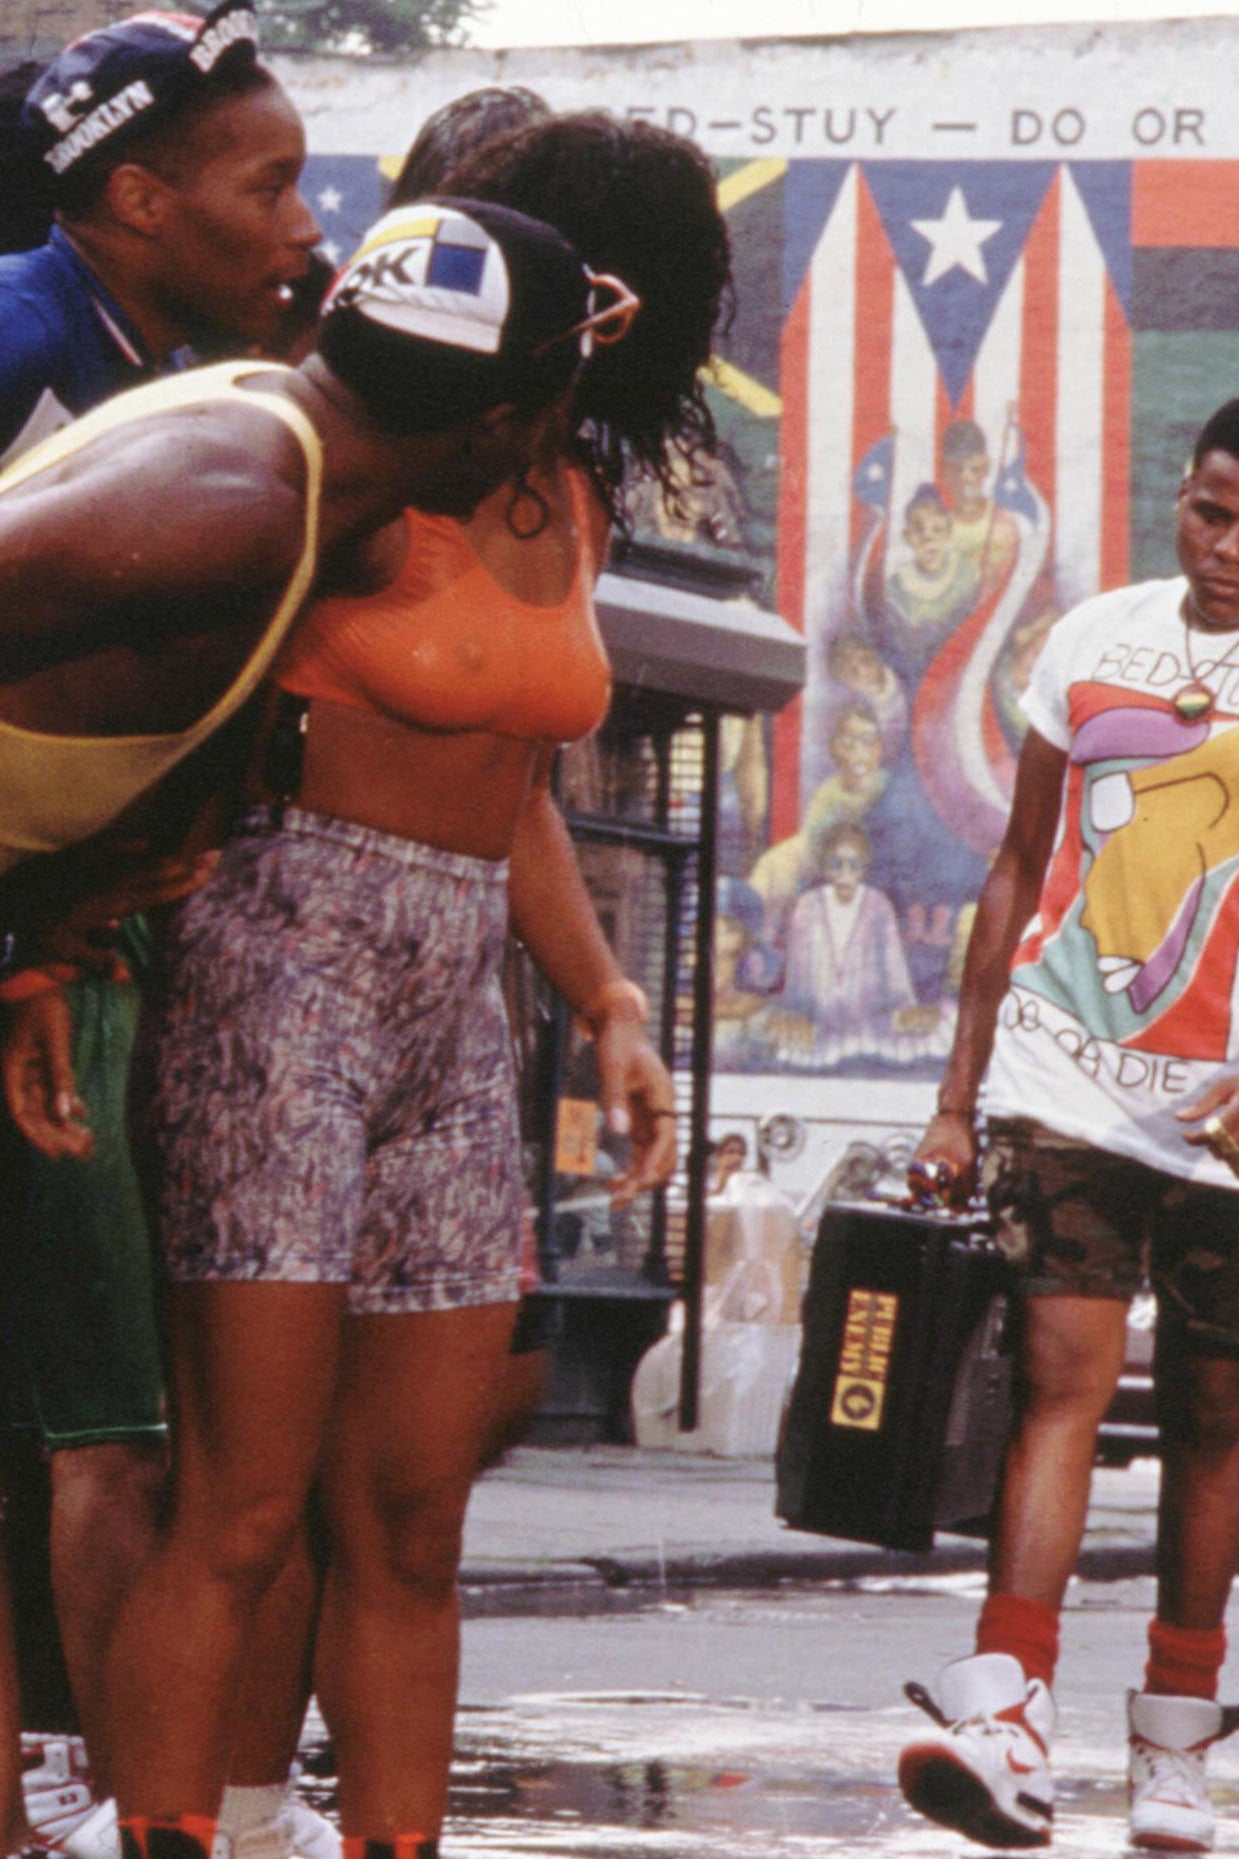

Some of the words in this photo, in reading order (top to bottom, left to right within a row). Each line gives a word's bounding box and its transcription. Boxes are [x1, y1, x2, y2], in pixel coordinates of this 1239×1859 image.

[1010, 108, 1087, 146] DO
[1131, 107, 1205, 146] OR
[1116, 1052, 1189, 1093] DIE
